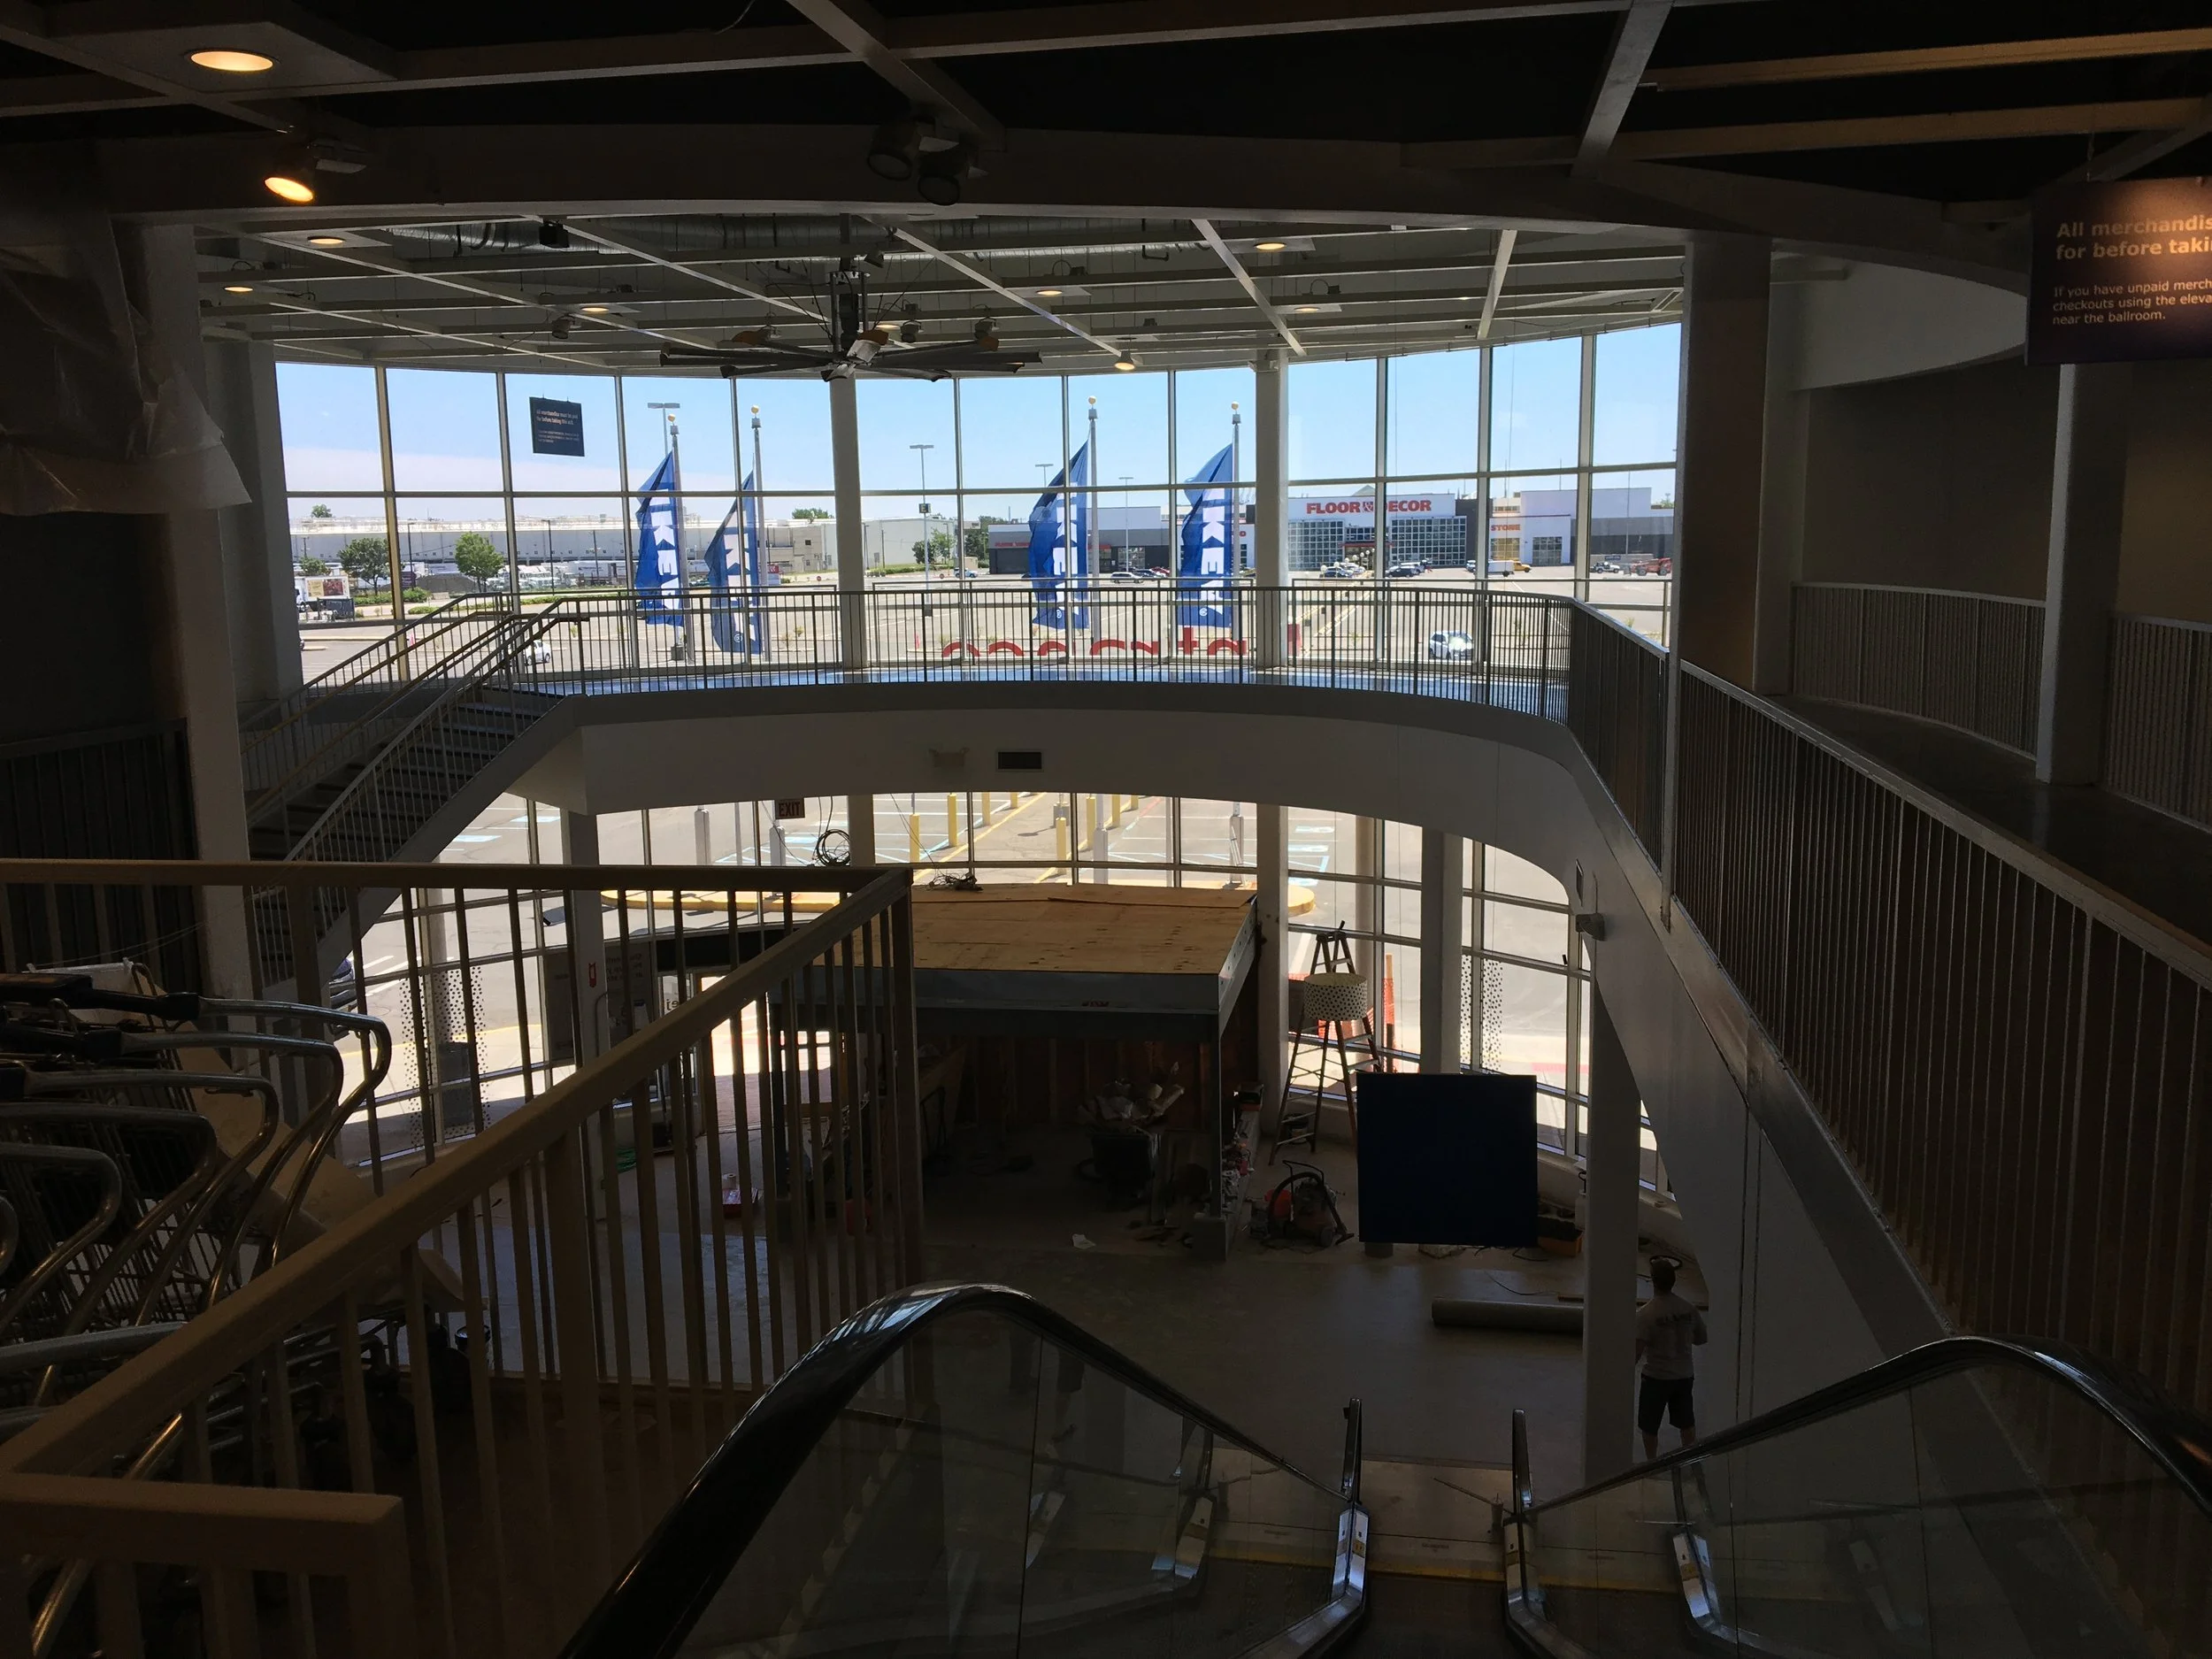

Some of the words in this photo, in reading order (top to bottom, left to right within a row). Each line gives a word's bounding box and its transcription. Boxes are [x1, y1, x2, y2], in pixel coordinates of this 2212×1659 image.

[2056, 222, 2084, 237] All
[2091, 215, 2212, 236] merchandis
[2056, 243, 2086, 260] for
[2093, 240, 2162, 258] before
[2169, 236, 2212, 254] taki
[2055, 287, 2062, 297] If
[2068, 287, 2089, 298] you
[2093, 285, 2123, 296] have
[2127, 280, 2169, 295] unpaid
[2173, 278, 2212, 291] merch
[2053, 297, 2114, 311] checkouts
[2118, 296, 2151, 309] using
[2155, 295, 2176, 305] the
[2180, 293, 2212, 305] eleva
[2053, 315, 2080, 325] near
[2084, 312, 2105, 323] the
[2108, 311, 2166, 323] ballroom.
[1306, 502, 1362, 514] FLOOR
[1386, 500, 1432, 512] ECOR
[778, 801, 801, 817] EXIT
